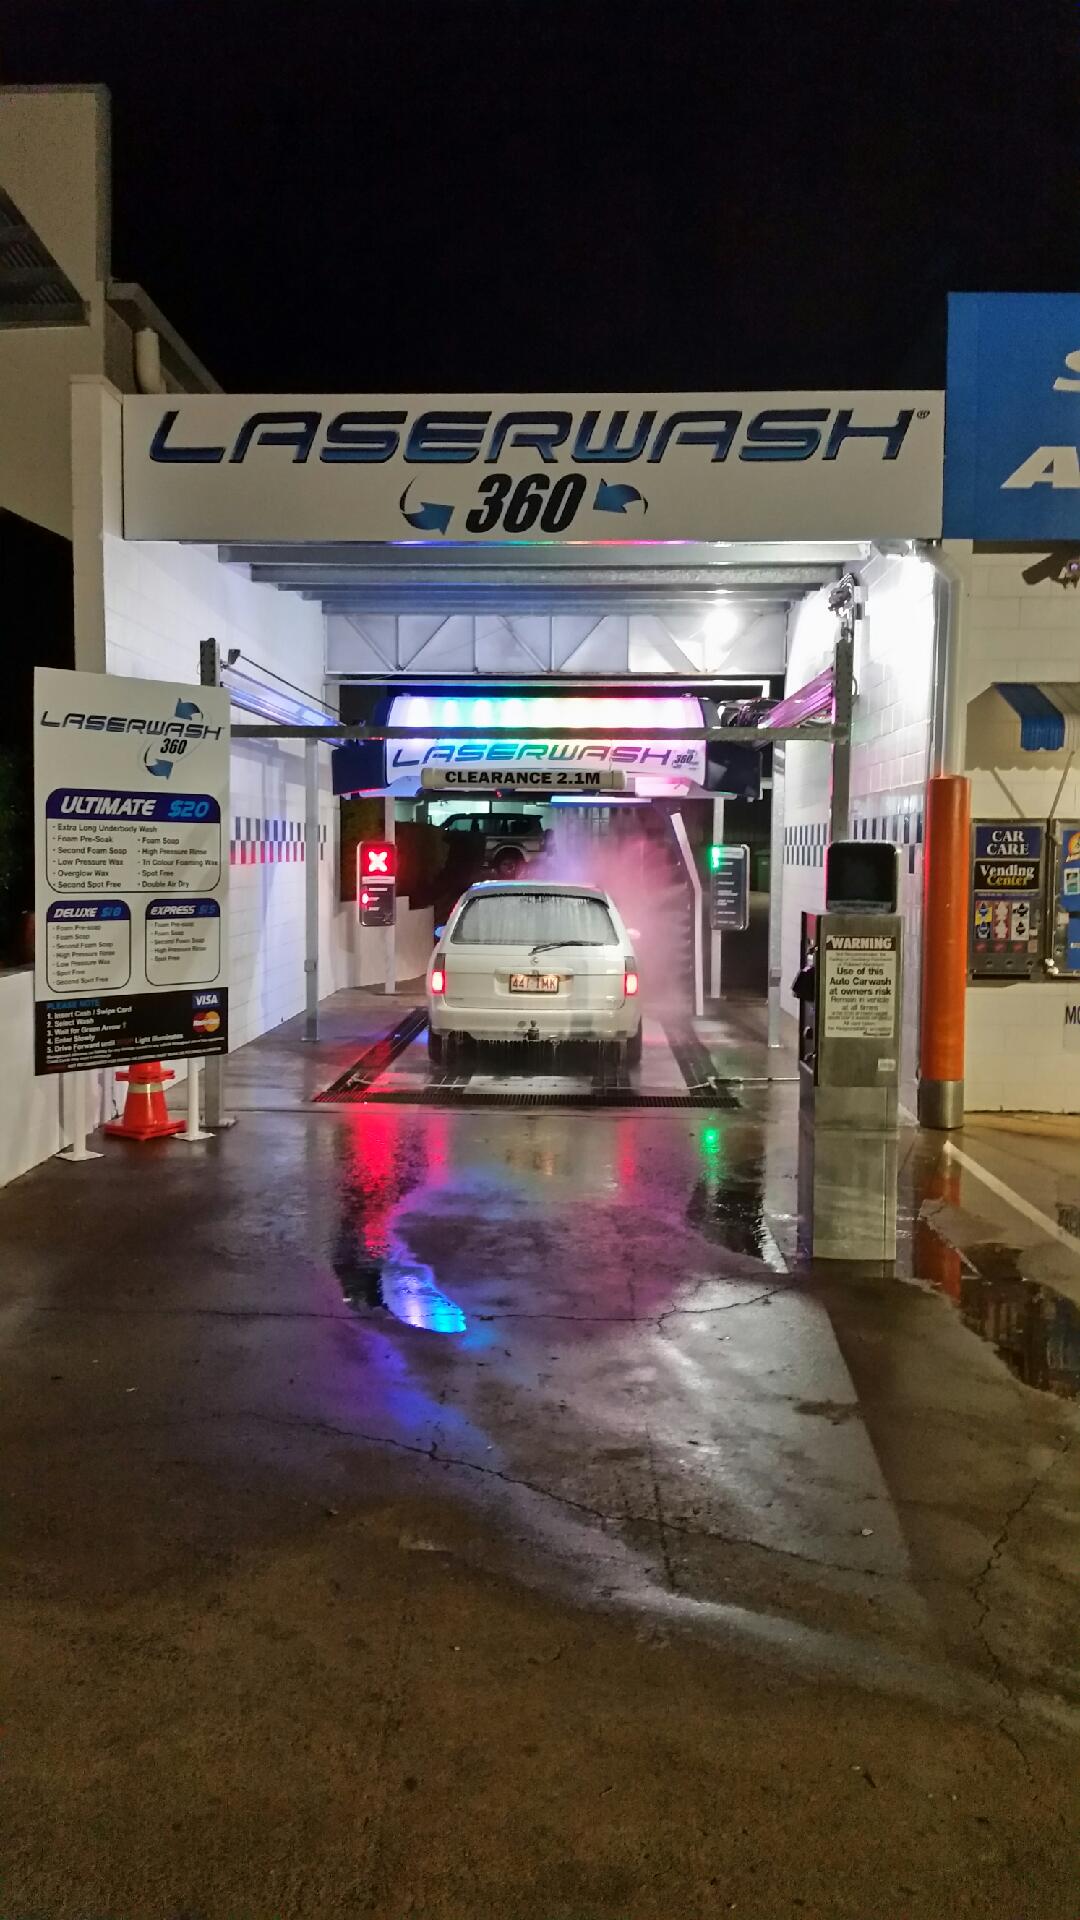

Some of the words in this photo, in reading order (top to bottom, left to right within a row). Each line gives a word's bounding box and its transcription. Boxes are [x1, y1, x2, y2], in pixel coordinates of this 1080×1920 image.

[149, 408, 914, 464] LASERWASH
[465, 472, 587, 534] 360
[40, 711, 222, 741] LASERWASH
[159, 738, 187, 755] 360
[393, 743, 672, 768] LASERWASH
[673, 754, 693, 764] 360
[445, 771, 552, 784] CLEARANCE
[556, 772, 600, 785] 2.1M
[60, 795, 156, 816] ULTIMATE
[167, 800, 209, 817] $20
[99, 825, 137, 833] Underbody
[992, 830, 1025, 842] CAR
[109, 847, 127, 855] Soap
[142, 848, 158, 856] High
[986, 843, 1030, 856] CARE
[58, 870, 92, 878] Overglow
[980, 864, 1035, 880] Vending
[178, 880, 189, 888] Dry
[986, 875, 1028, 887] Center
[53, 907, 98, 918] DELUXE
[150, 905, 196, 915] EXPRESS
[832, 937, 892, 949] WARNING
[837, 967, 854, 975] Use
[857, 967, 866, 975] of
[868, 967, 884, 975] this
[829, 977, 849, 985] Auto
[852, 977, 892, 985] Carwash
[829, 987, 838, 995] at
[875, 987, 891, 995] risk
[196, 995, 218, 1005] VISA
[116, 1006, 132, 1014] Card
